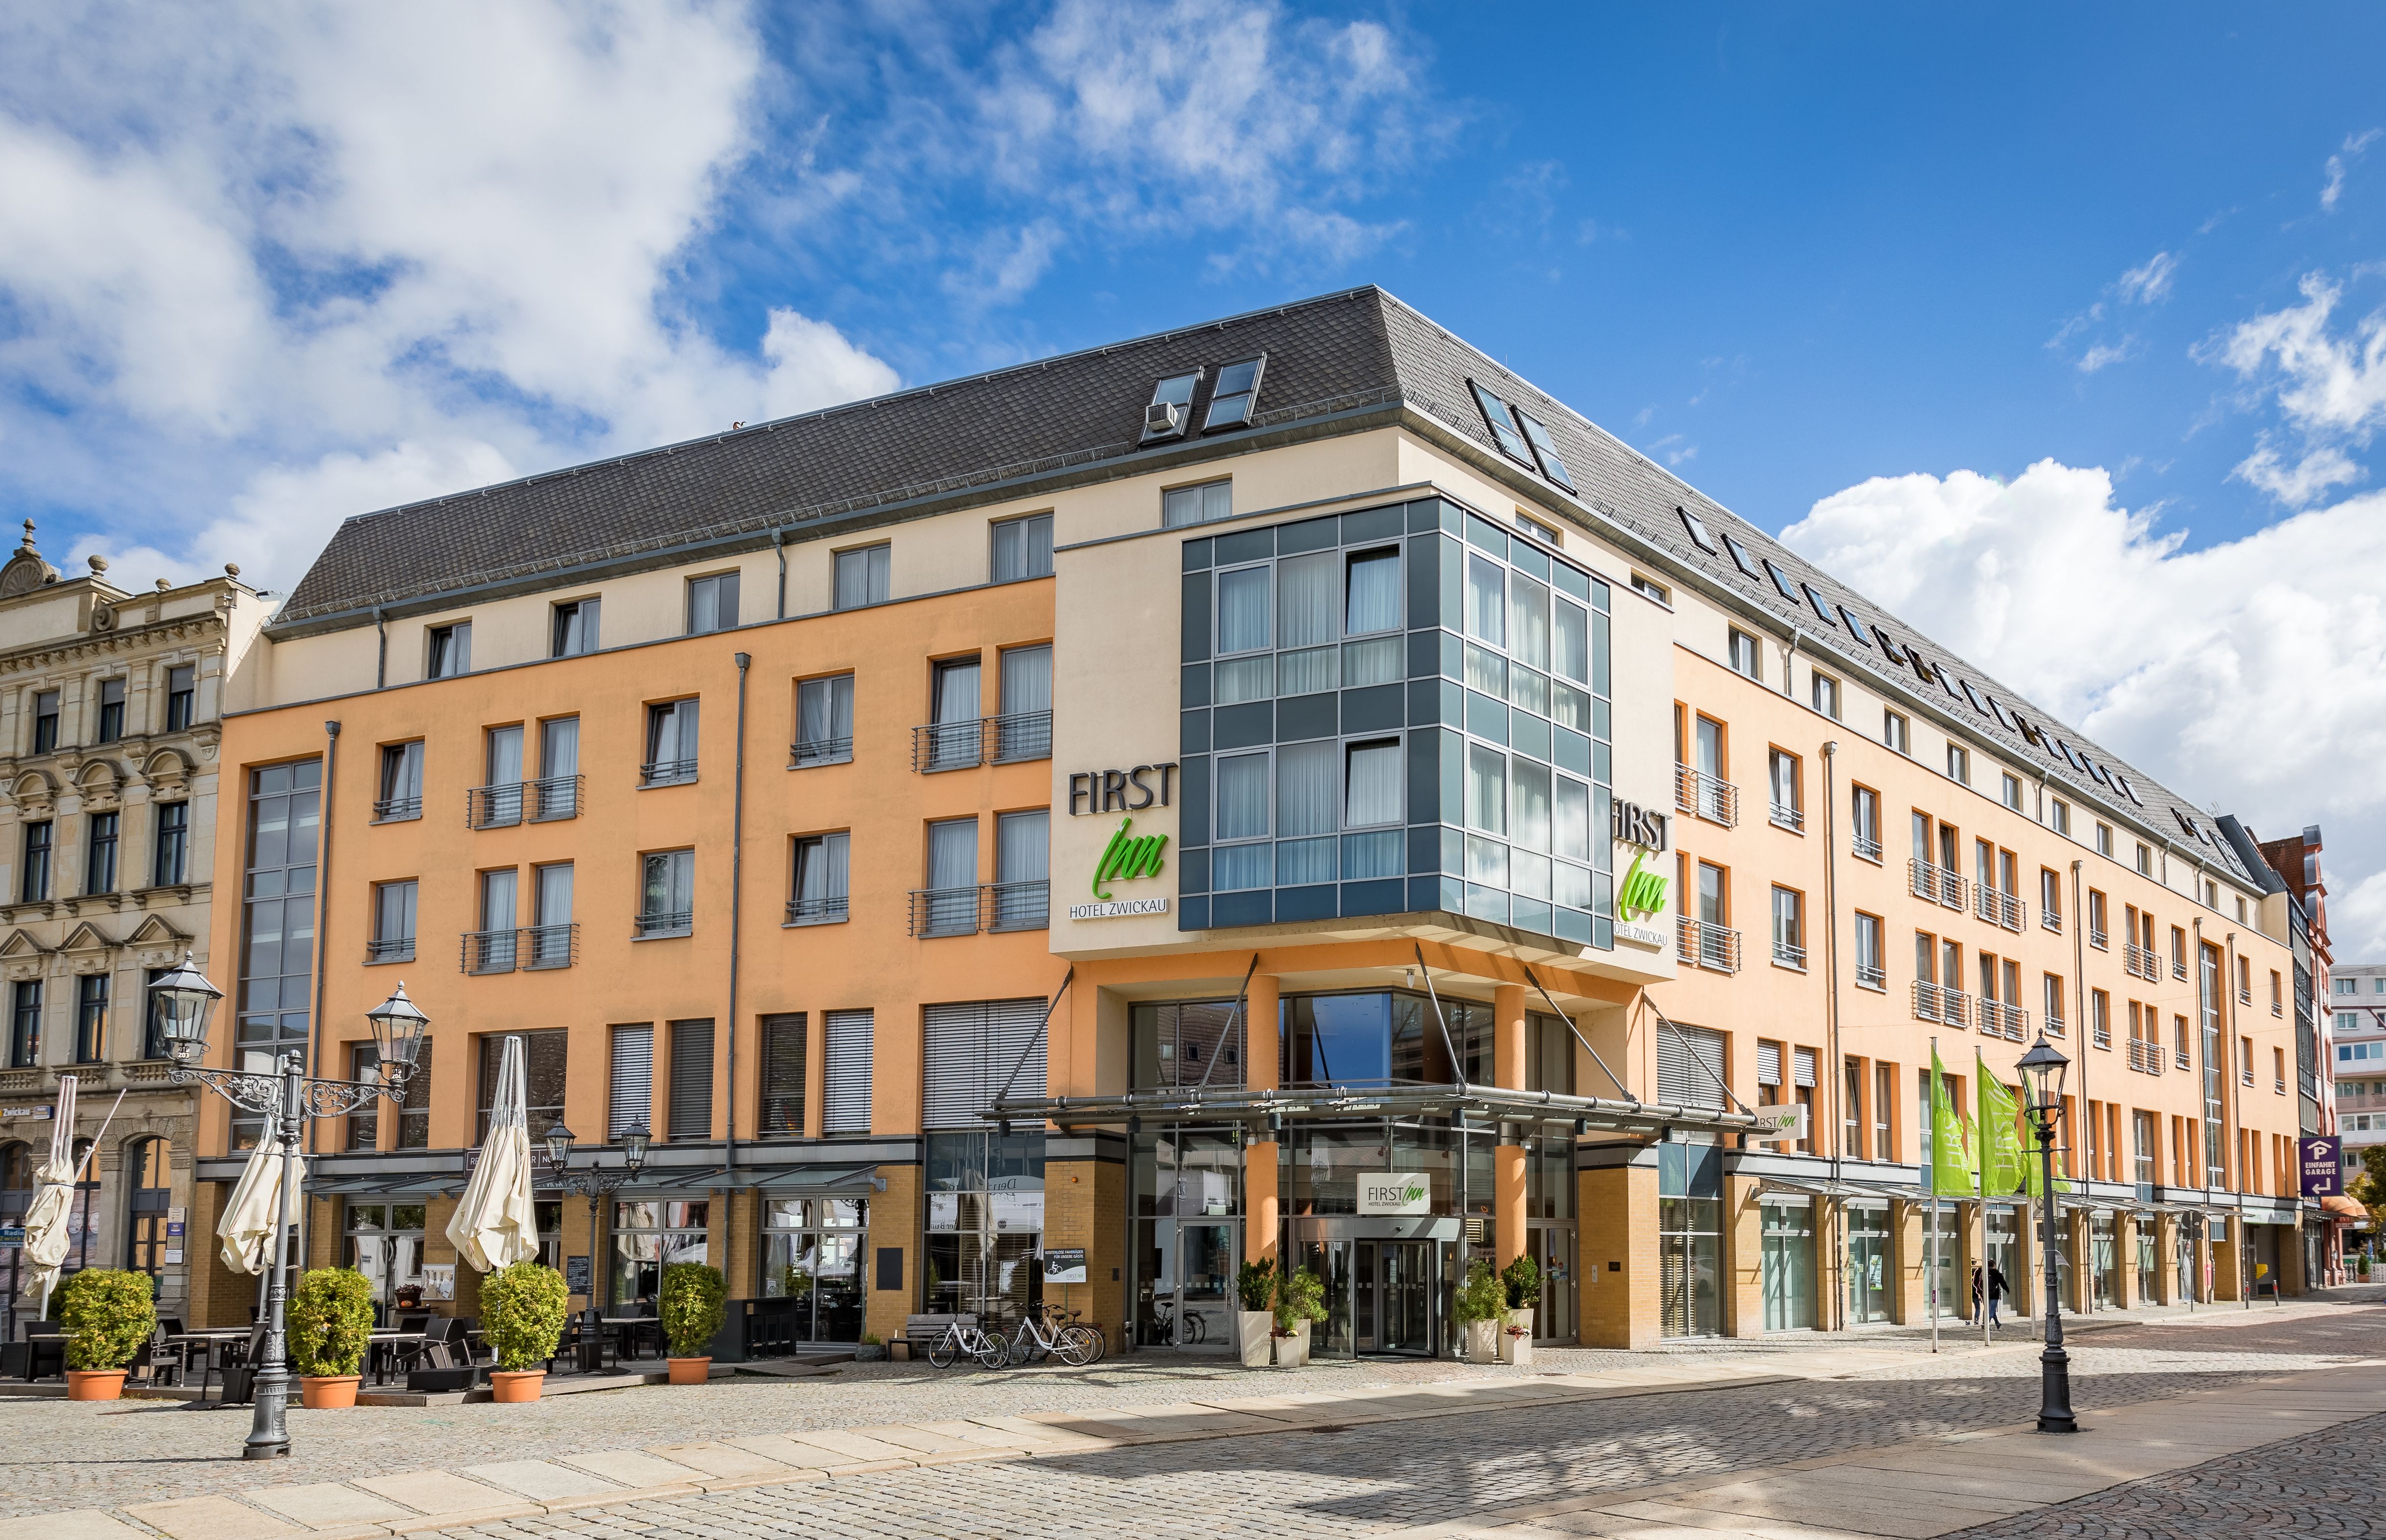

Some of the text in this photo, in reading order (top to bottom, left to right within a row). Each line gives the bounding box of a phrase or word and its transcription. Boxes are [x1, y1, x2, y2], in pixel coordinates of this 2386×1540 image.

[1069, 762, 1179, 816] FIRST
[1070, 899, 1166, 919] HOTEL ZWICKAU
[1614, 923, 1668, 946] OTEL ZWICKAU
[3, 1107, 30, 1116] Zwickau
[2314, 1146, 2327, 1160] P
[1369, 1181, 1425, 1207] FIRST inn
